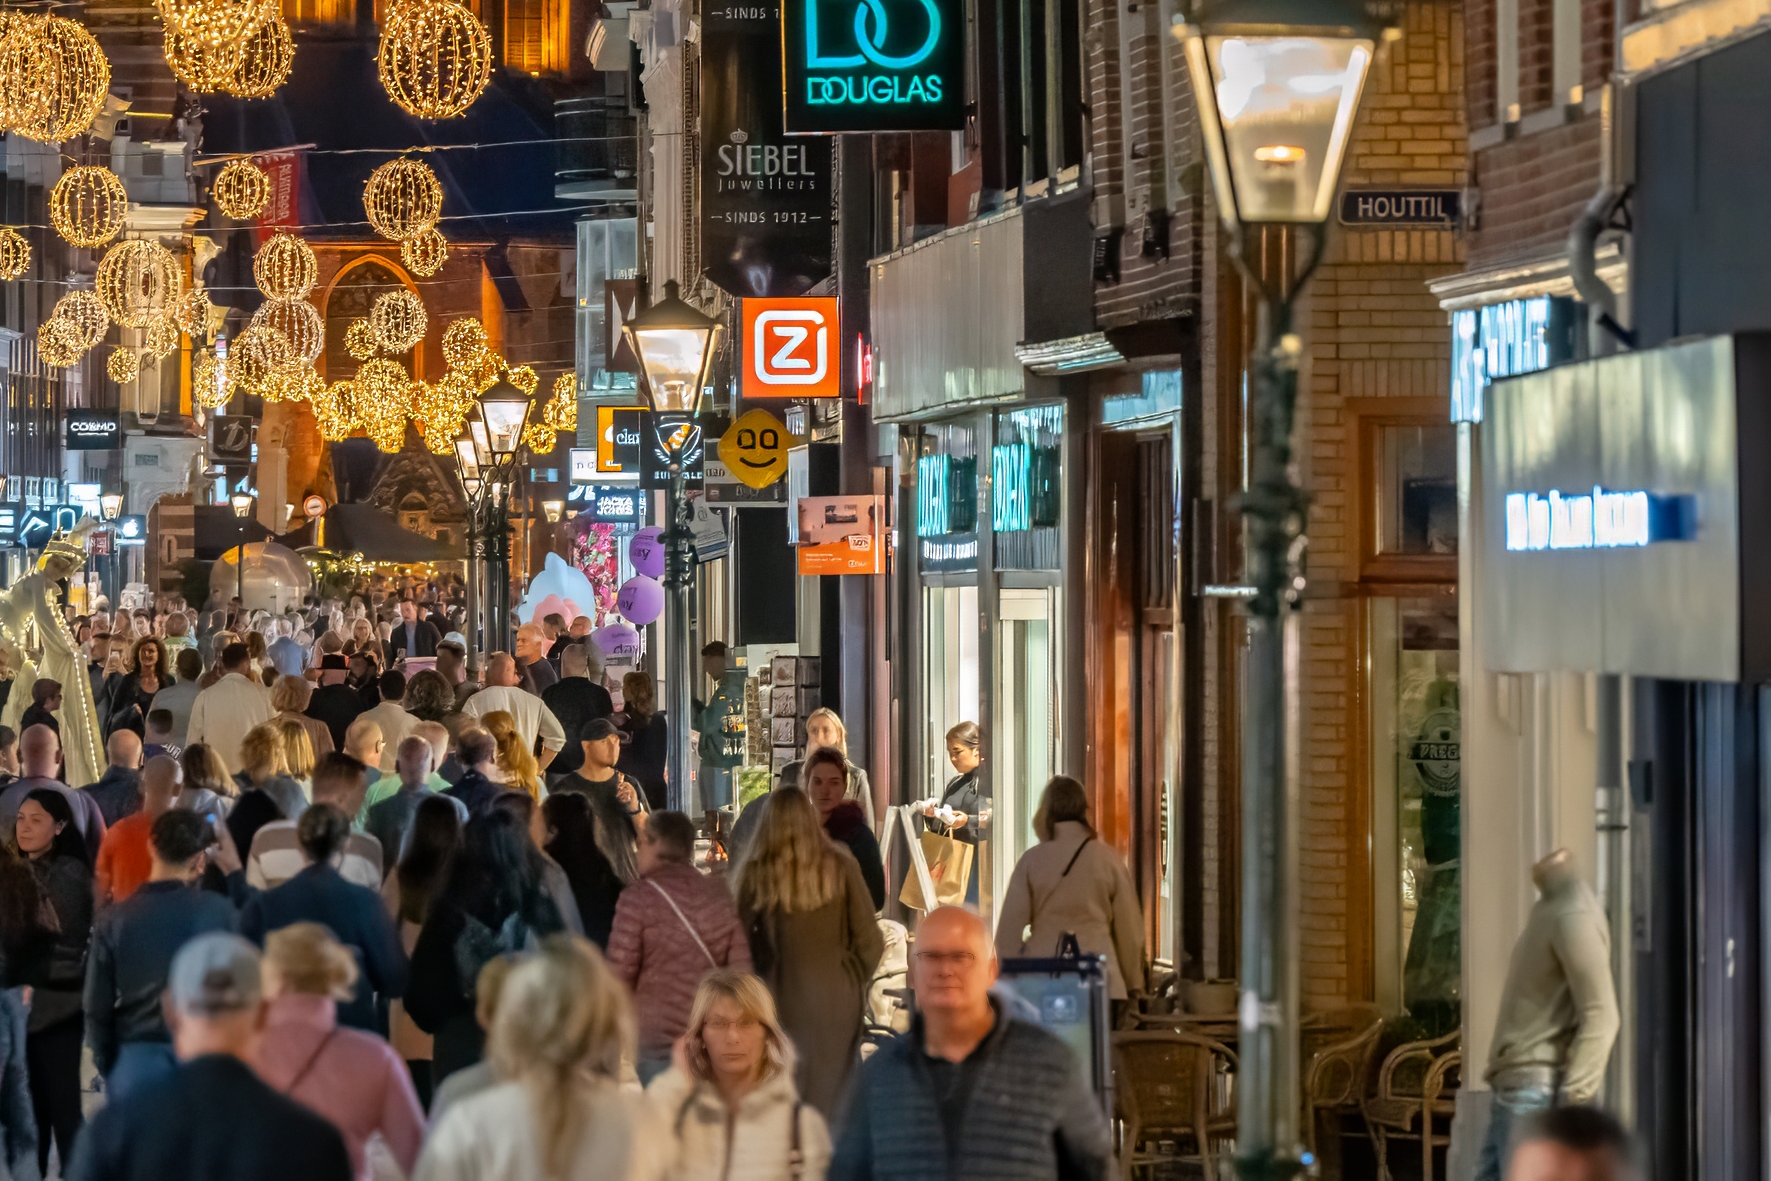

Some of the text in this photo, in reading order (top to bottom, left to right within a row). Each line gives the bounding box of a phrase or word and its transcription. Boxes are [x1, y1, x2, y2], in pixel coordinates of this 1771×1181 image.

[726, 7, 766, 19] SINDS
[807, 75, 943, 105] DOUGLAS
[717, 144, 816, 176] SIEBEL
[725, 211, 807, 223] SINDS 1912
[1358, 196, 1447, 218] HOUTTIL
